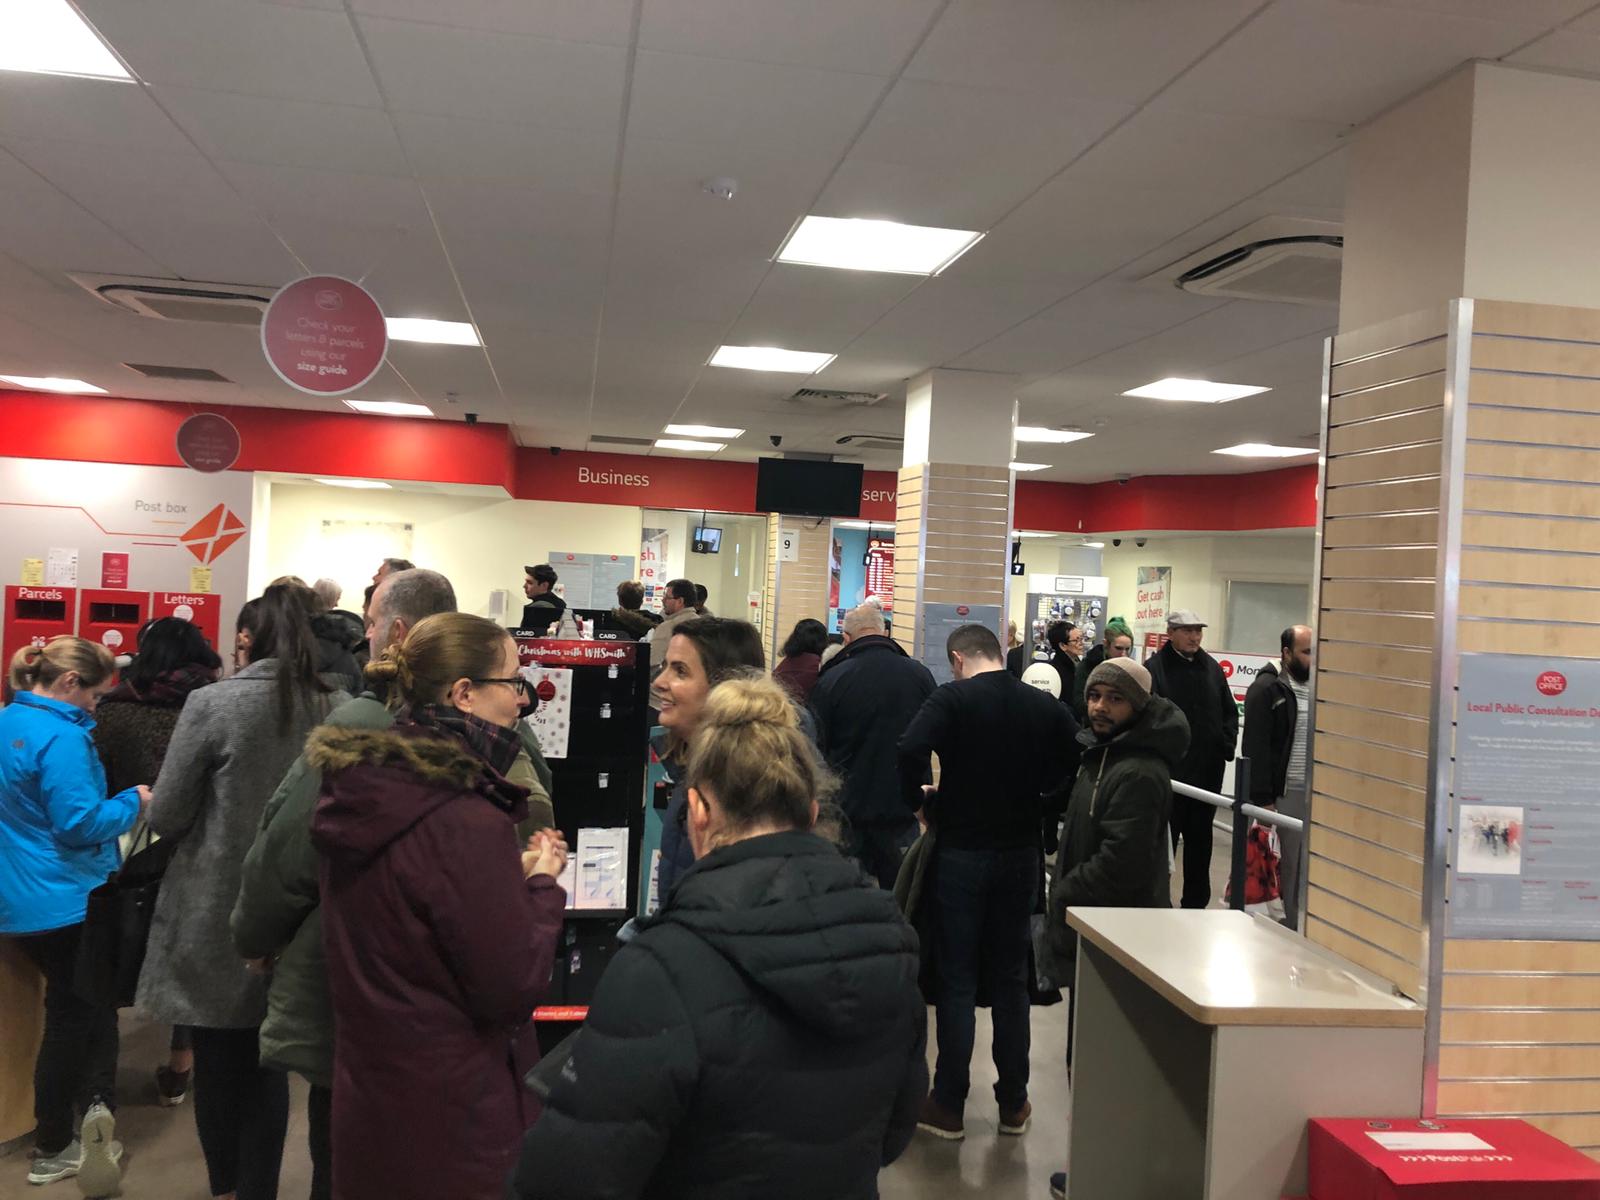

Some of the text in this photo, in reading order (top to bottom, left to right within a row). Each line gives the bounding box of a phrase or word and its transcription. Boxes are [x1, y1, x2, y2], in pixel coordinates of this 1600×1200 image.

[297, 361, 348, 376] size guide
[578, 466, 650, 487] Business
[862, 490, 895, 502] serv
[135, 500, 188, 514] Post box
[697, 543, 703, 551] 9
[784, 539, 791, 549] 9
[1014, 564, 1021, 574] 7
[18, 587, 62, 600] Parcels
[164, 593, 205, 606] Letters
[1137, 586, 1164, 603] Get cash
[1136, 604, 1163, 620] out here
[518, 644, 626, 659] Christmas with WHSmith
[1543, 675, 1561, 683] POST
[1539, 683, 1563, 691] OFFICE
[1467, 702, 1493, 712] Local
[1495, 703, 1525, 714] Public
[1527, 705, 1587, 717] Consultation
